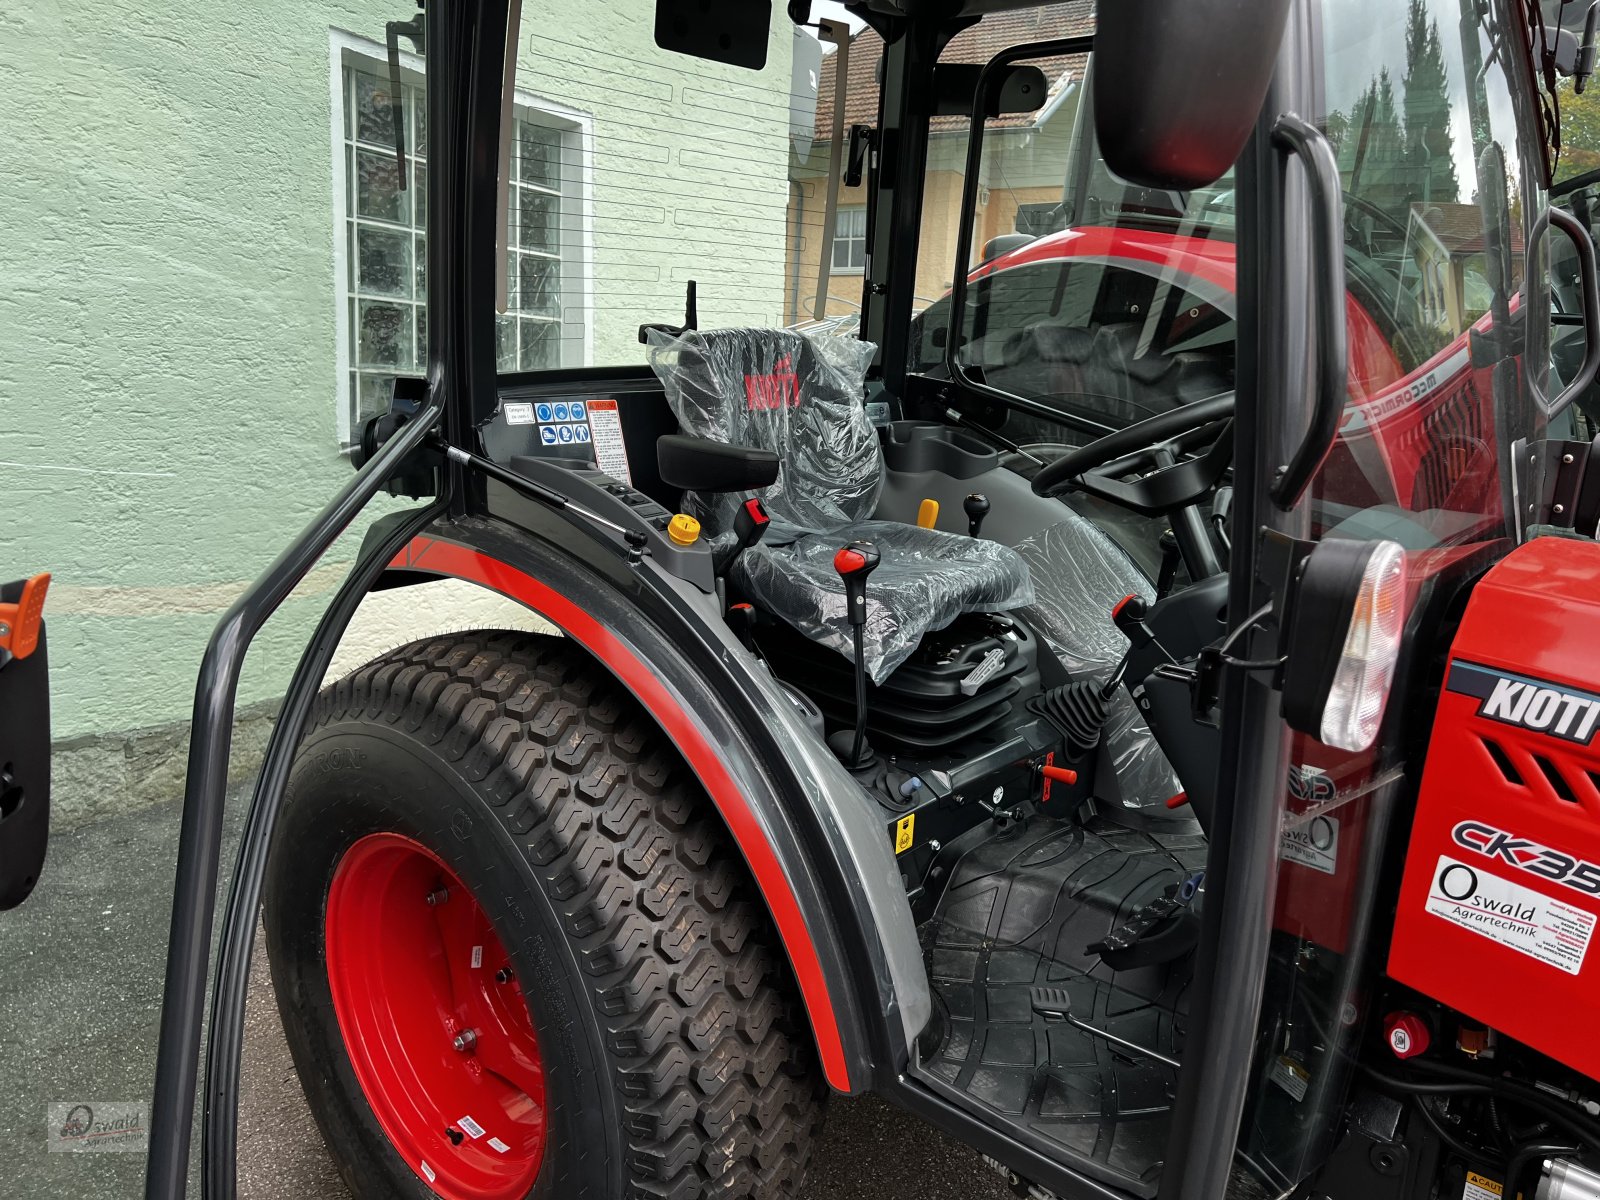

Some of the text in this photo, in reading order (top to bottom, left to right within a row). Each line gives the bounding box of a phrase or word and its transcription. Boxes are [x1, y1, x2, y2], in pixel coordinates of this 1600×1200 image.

[1483, 678, 1600, 740] KIOTI
[1439, 863, 1536, 922] Oswald
[1452, 906, 1537, 938] Agrartechnik
